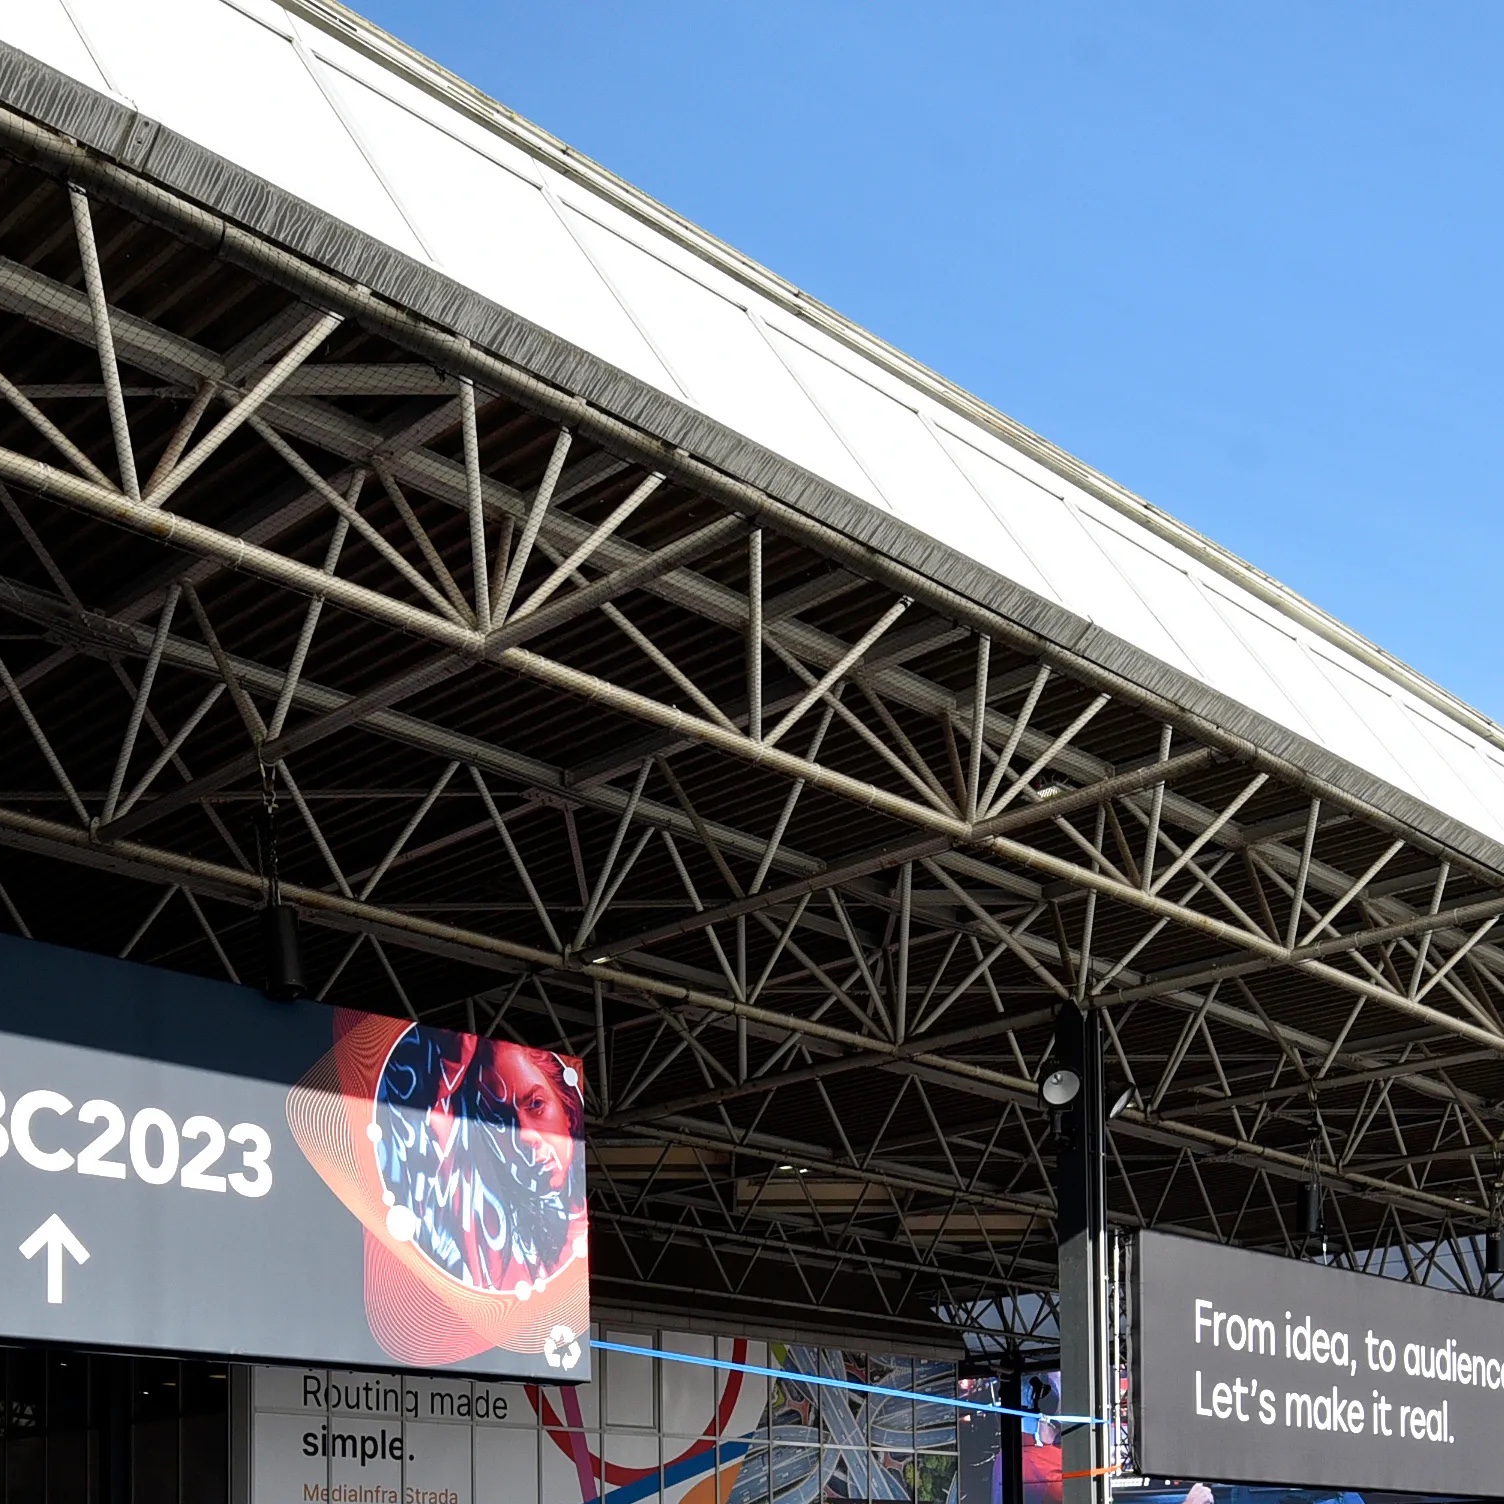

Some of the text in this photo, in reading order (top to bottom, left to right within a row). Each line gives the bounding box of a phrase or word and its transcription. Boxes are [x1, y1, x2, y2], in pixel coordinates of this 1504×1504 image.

[1195, 1299, 1276, 1357] From
[1285, 1311, 1357, 1377] idea,
[1365, 1327, 1397, 1373] to
[303, 1375, 508, 1421] Routing made
[1285, 1386, 1365, 1435] make
[1372, 1398, 1393, 1437] it
[1400, 1401, 1456, 1444] real.
[303, 1424, 415, 1466] simple.
[303, 1483, 398, 1504] MediaInfra
